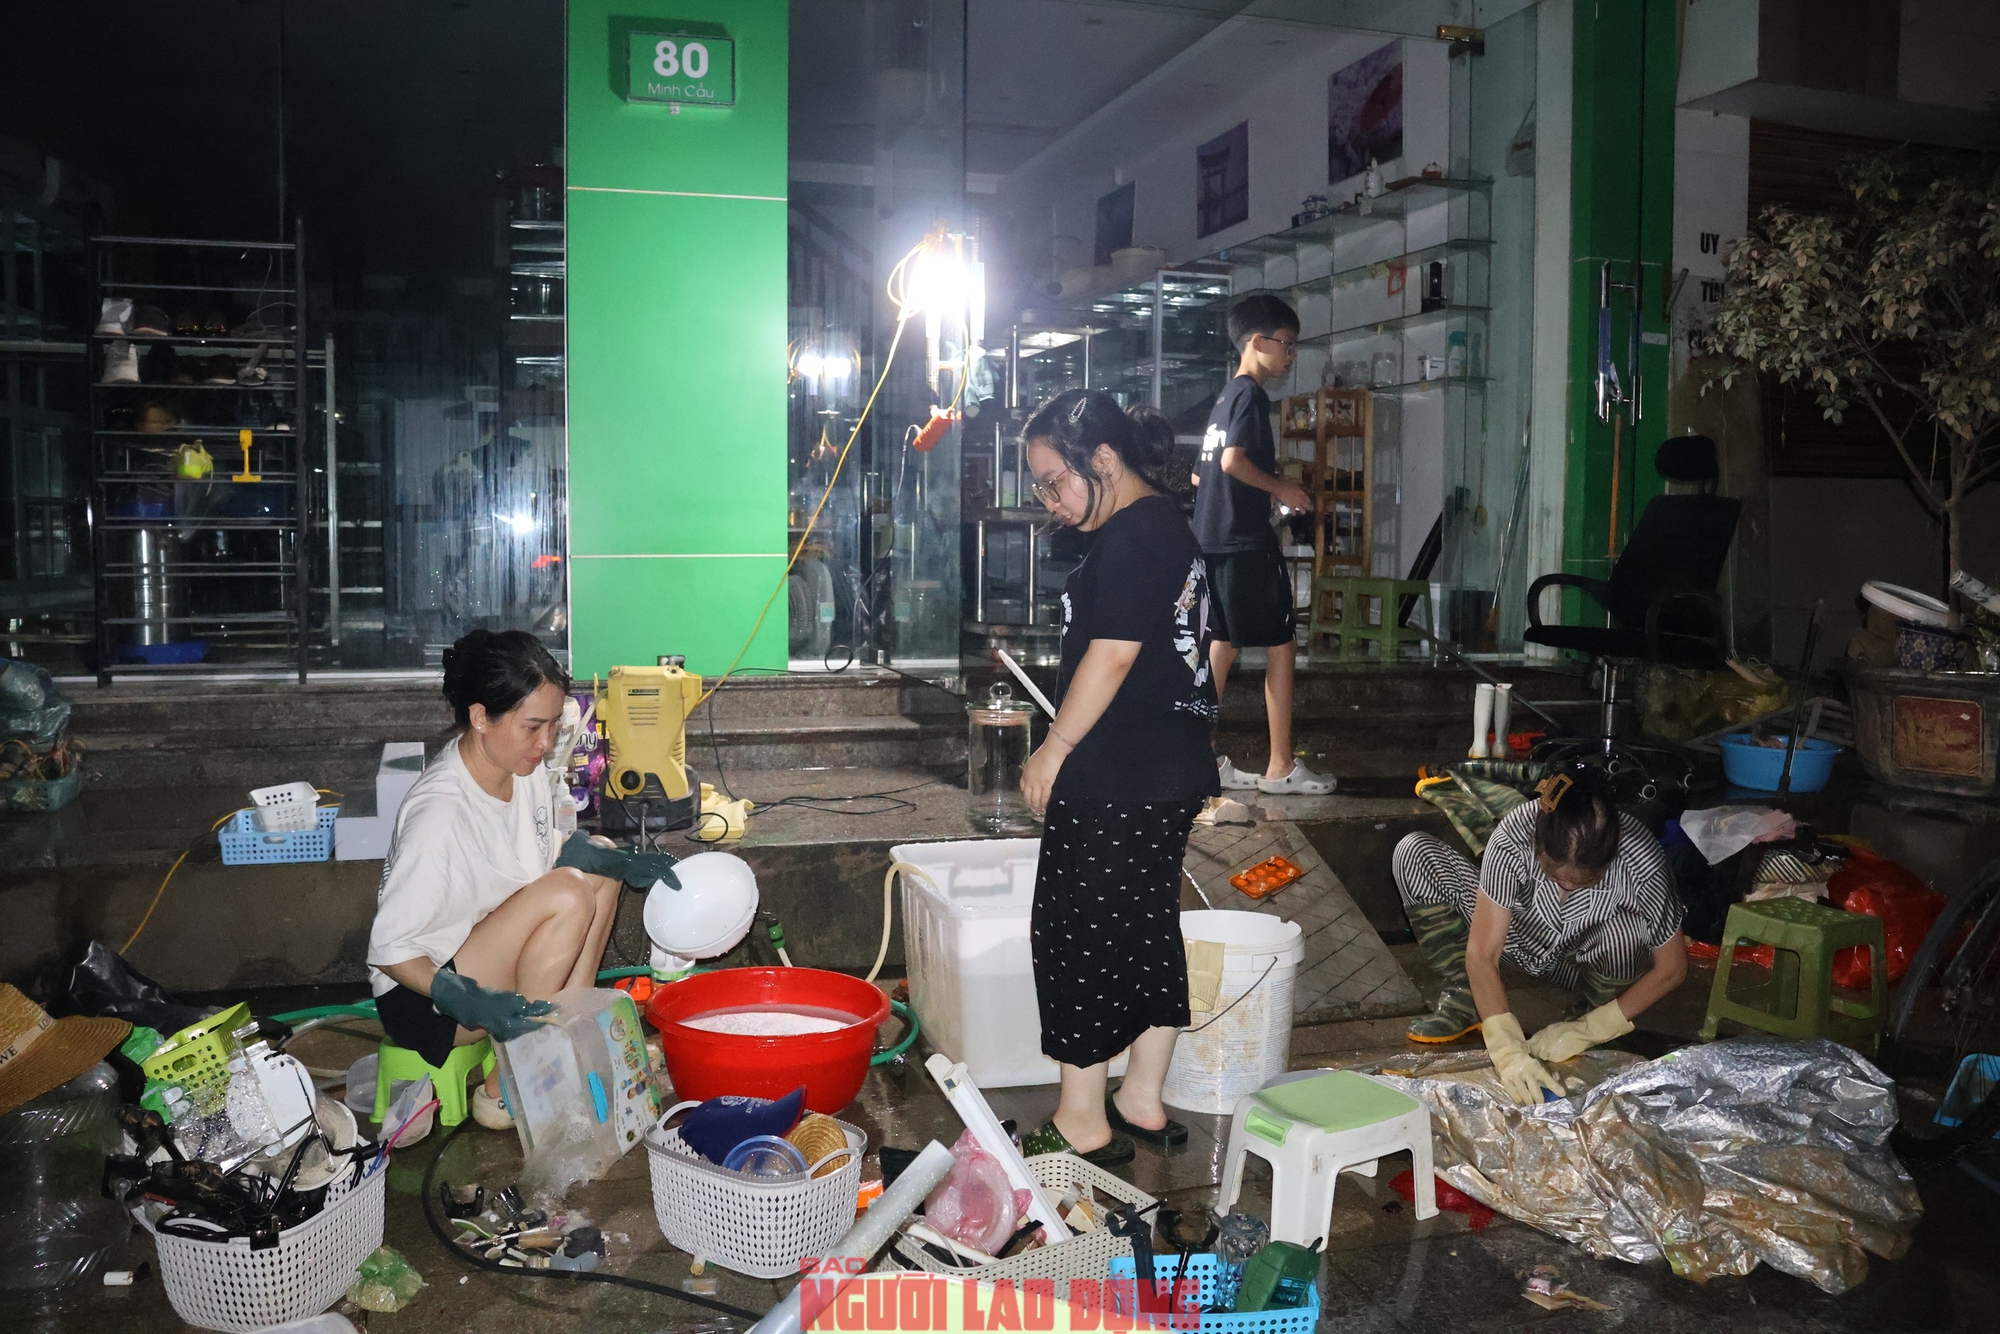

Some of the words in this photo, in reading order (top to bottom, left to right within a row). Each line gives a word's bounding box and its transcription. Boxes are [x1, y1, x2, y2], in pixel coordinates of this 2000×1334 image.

[653, 40, 709, 79] 80
[647, 83, 681, 96] Minh
[1700, 232, 1720, 254] UY
